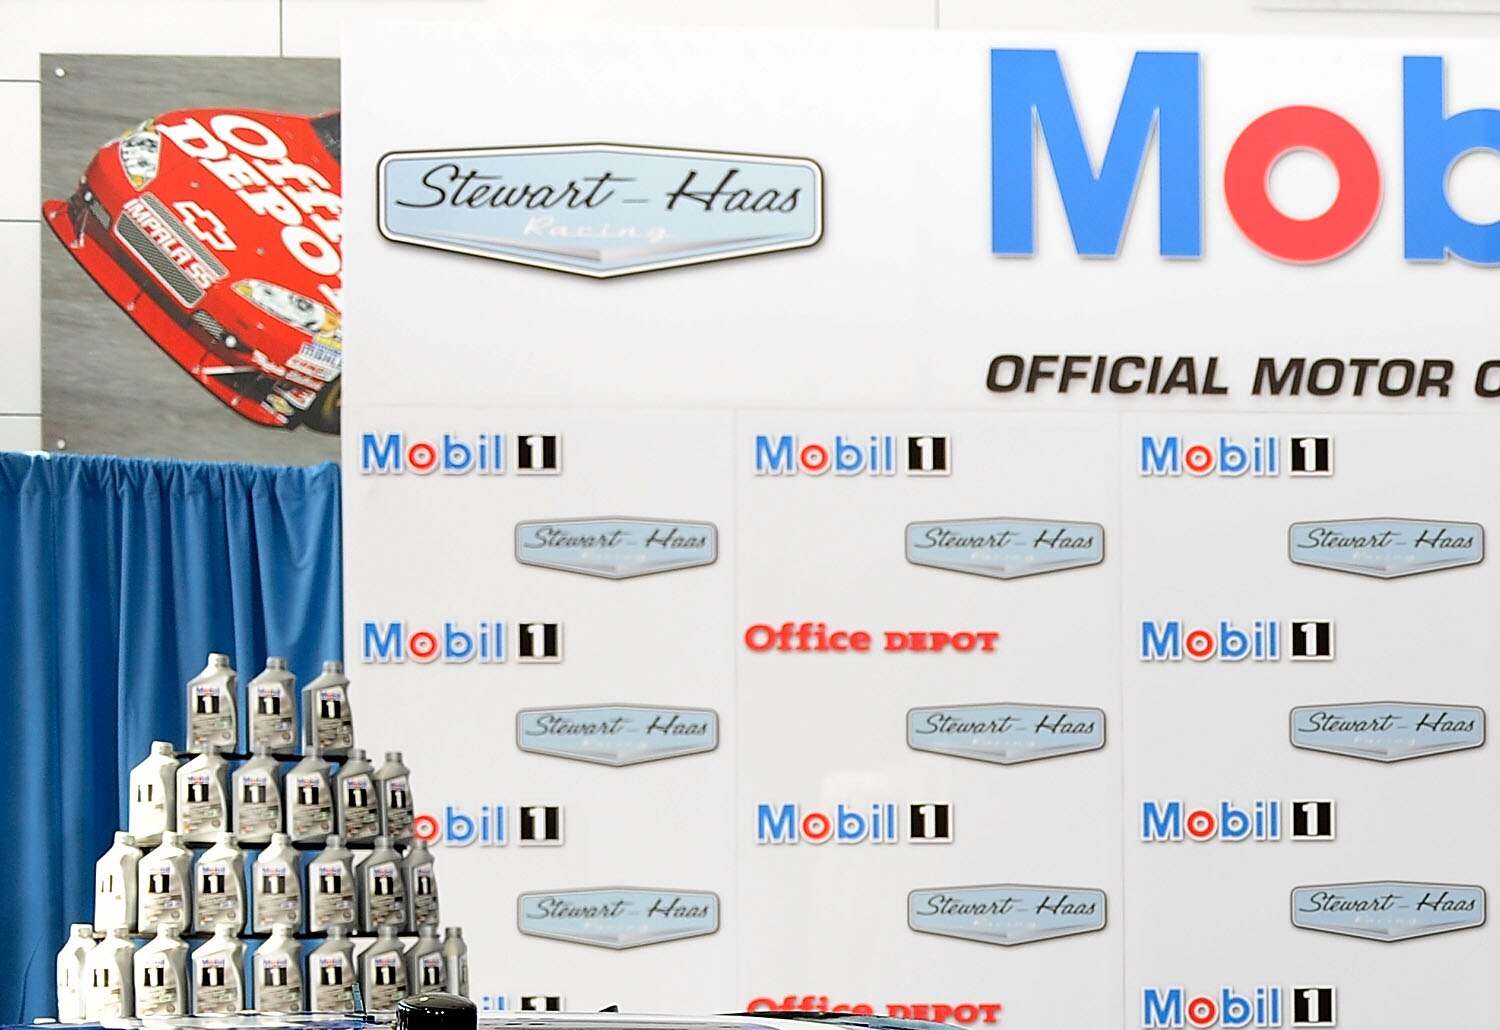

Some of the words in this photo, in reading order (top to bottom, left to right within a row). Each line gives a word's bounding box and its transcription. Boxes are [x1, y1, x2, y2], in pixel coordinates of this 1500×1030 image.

[210, 114, 342, 243] Offi
[396, 164, 637, 209] Stewart
[667, 169, 802, 213] Haas
[122, 197, 193, 268] IMPALA
[186, 258, 218, 291] SS
[523, 216, 672, 242] Racing
[986, 354, 1228, 395] OFFICIAL
[1252, 357, 1454, 397] MOTOR
[362, 433, 501, 471] Mobil
[756, 435, 892, 472] Mobil
[1141, 436, 1276, 473] Mobil
[524, 526, 627, 548] Stewart
[645, 527, 706, 548] Haas
[914, 527, 1018, 548] Stewart
[1033, 528, 1094, 549] Haas
[1297, 527, 1400, 548] Stewart
[1414, 528, 1474, 548] Haas
[364, 622, 503, 659] Mobil
[744, 622, 871, 651] Office
[885, 632, 999, 652] DEPOT
[1142, 621, 1277, 658] Mobil
[525, 713, 629, 736] Stewart
[647, 713, 708, 735] Haas
[916, 712, 1020, 734] Stewart
[1035, 713, 1095, 734] Haas
[1298, 711, 1402, 732] Stewart
[1416, 712, 1475, 732] Haas
[412, 806, 504, 843] obil
[758, 803, 894, 840] Mobil
[1143, 801, 1278, 839] Mobil
[527, 897, 629, 919] Stewart
[648, 897, 709, 918] Haas
[916, 893, 1021, 916] Stewart
[1036, 894, 1096, 915] Haas
[1298, 891, 1404, 912] Stewart
[1416, 891, 1476, 911] Haas
[1144, 988, 1279, 1025] Mobil
